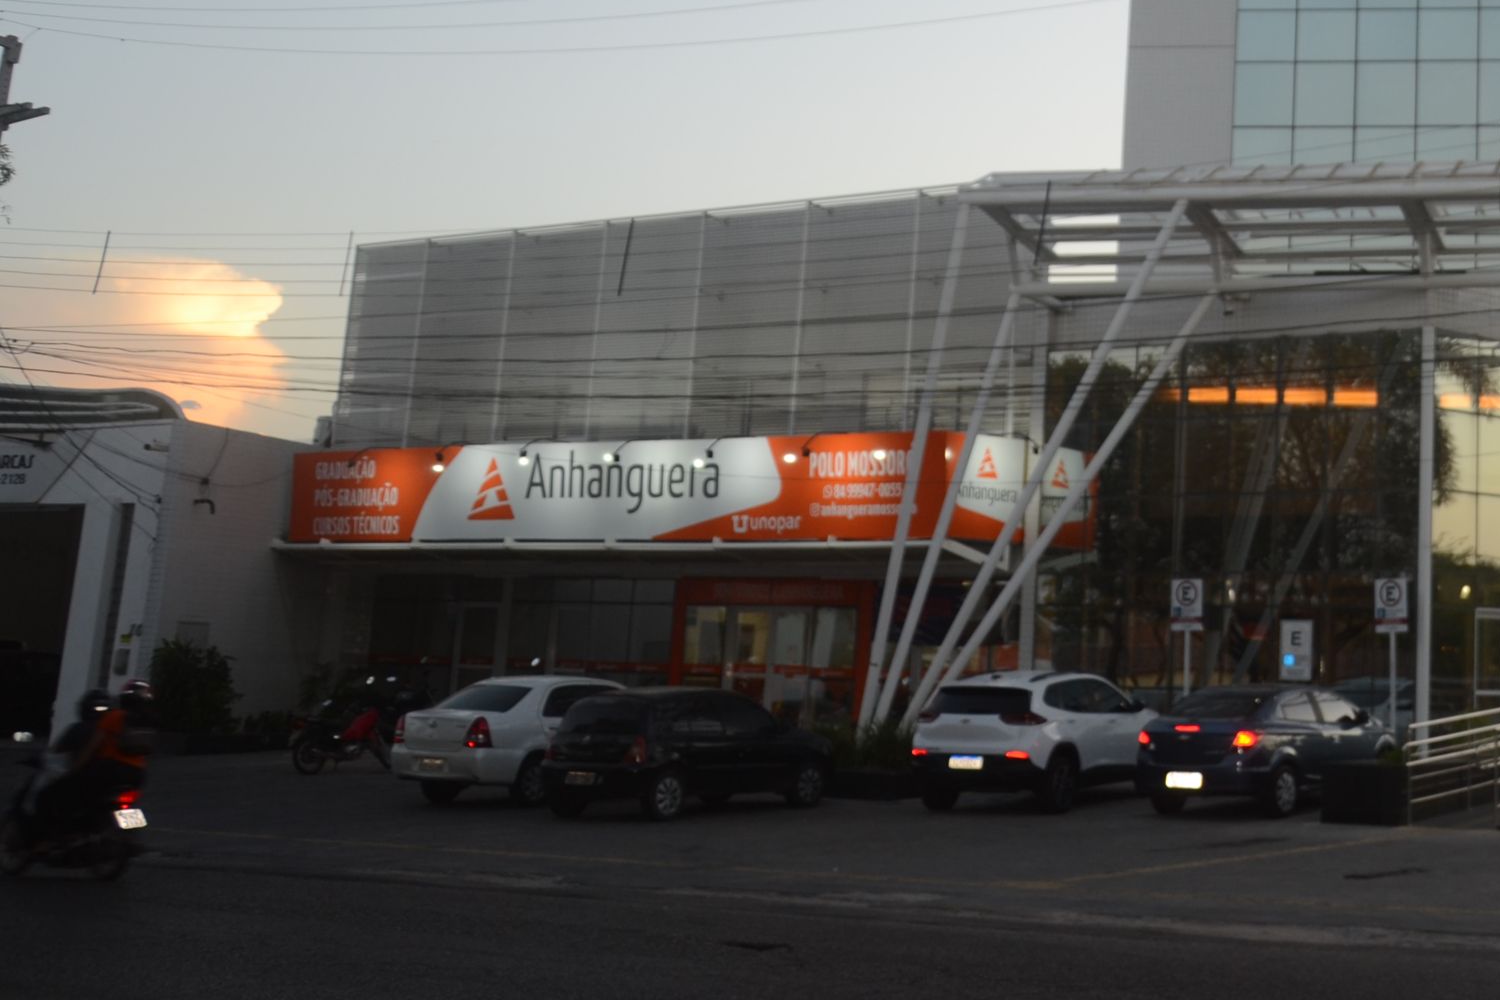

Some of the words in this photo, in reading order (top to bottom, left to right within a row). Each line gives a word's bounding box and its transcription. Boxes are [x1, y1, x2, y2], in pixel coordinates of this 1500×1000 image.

[314, 456, 377, 484] GRADUAÇÃO
[808, 451, 845, 478] POLO
[525, 450, 719, 514] Anhanguera
[313, 481, 400, 511] PÓS-GRADUAÇÃO
[313, 516, 350, 536] CURSOS
[352, 511, 401, 535] TÉCNICOS
[749, 516, 802, 533] unopar
[1182, 585, 1191, 602] E
[1386, 585, 1395, 602] E
[1291, 630, 1302, 646] E
